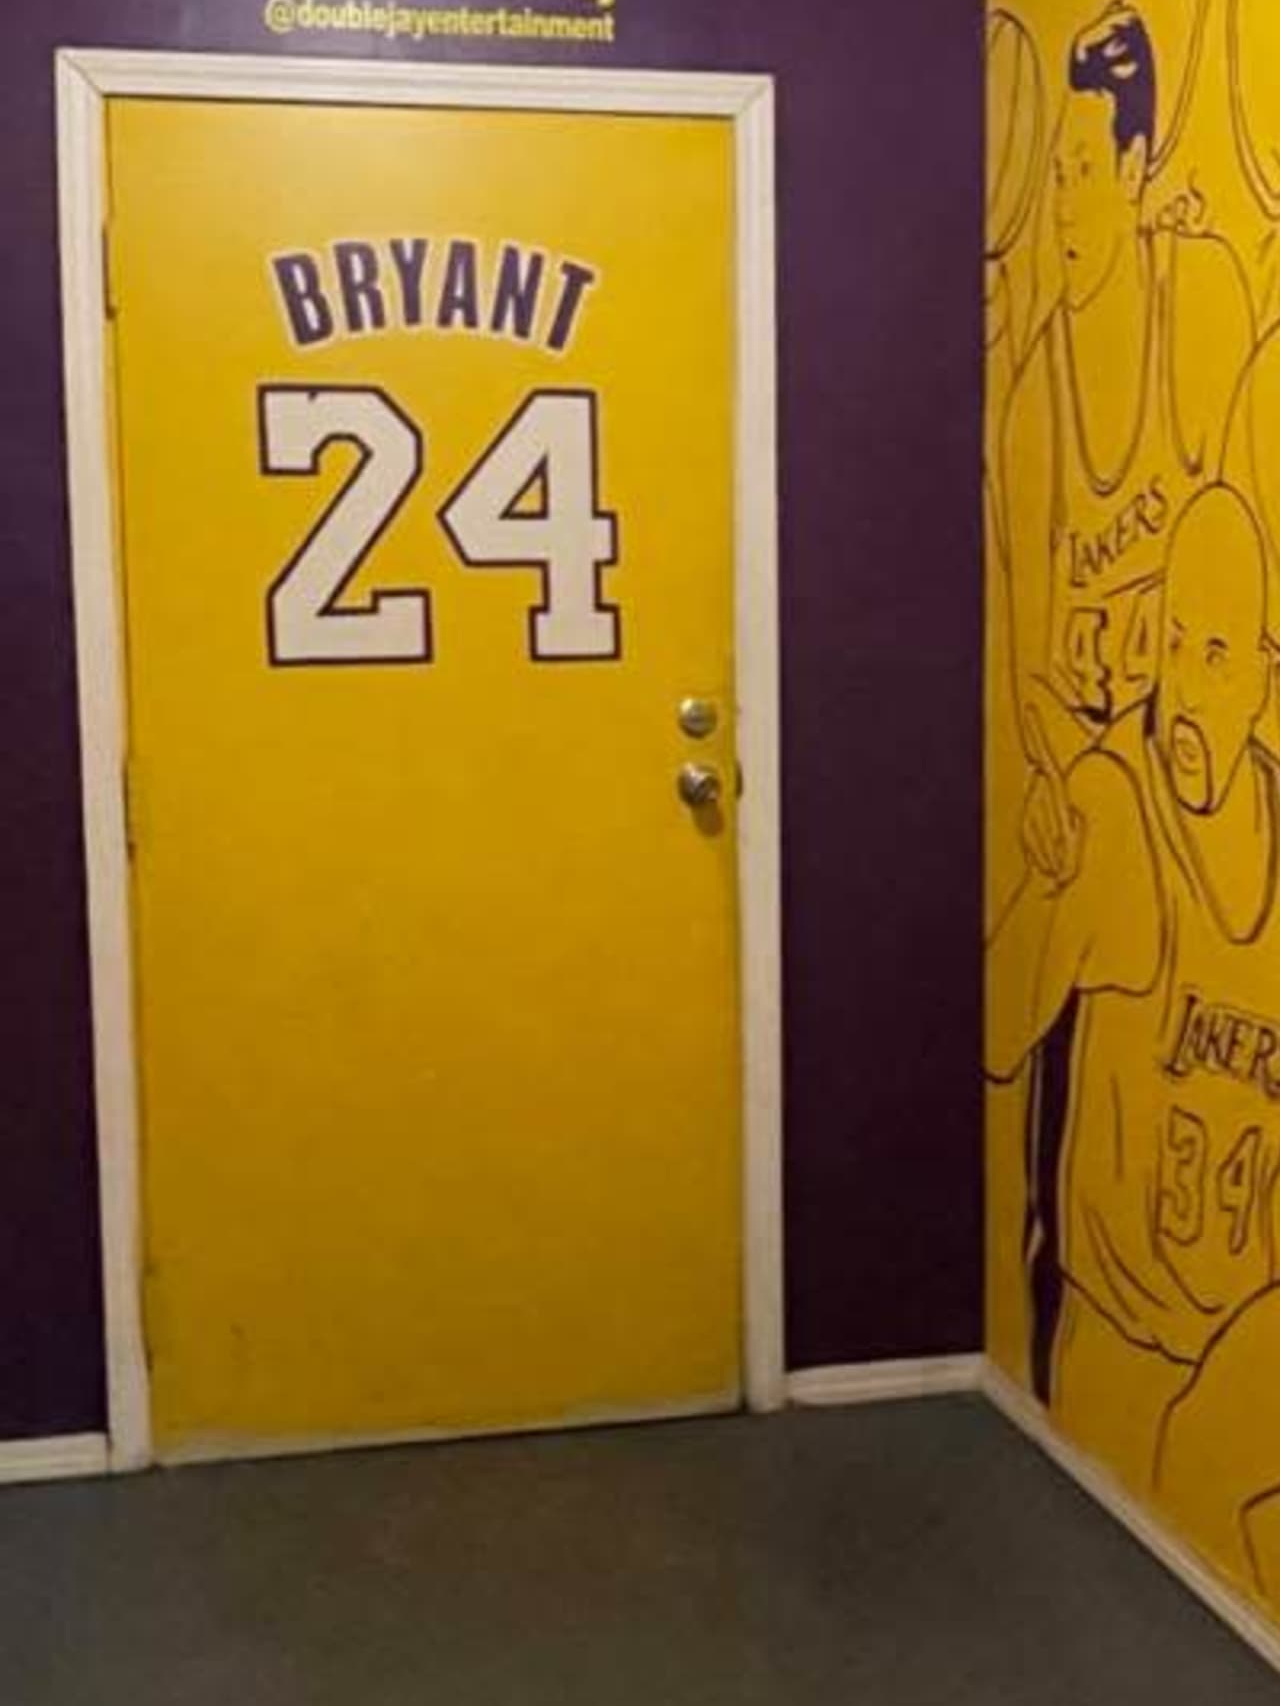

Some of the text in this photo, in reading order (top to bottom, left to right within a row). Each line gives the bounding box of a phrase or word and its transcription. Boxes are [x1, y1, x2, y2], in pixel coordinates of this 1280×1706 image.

[272, 237, 597, 353] BRYANT
[257, 382, 623, 668] 24
[1156, 1103, 1264, 1256] 34
